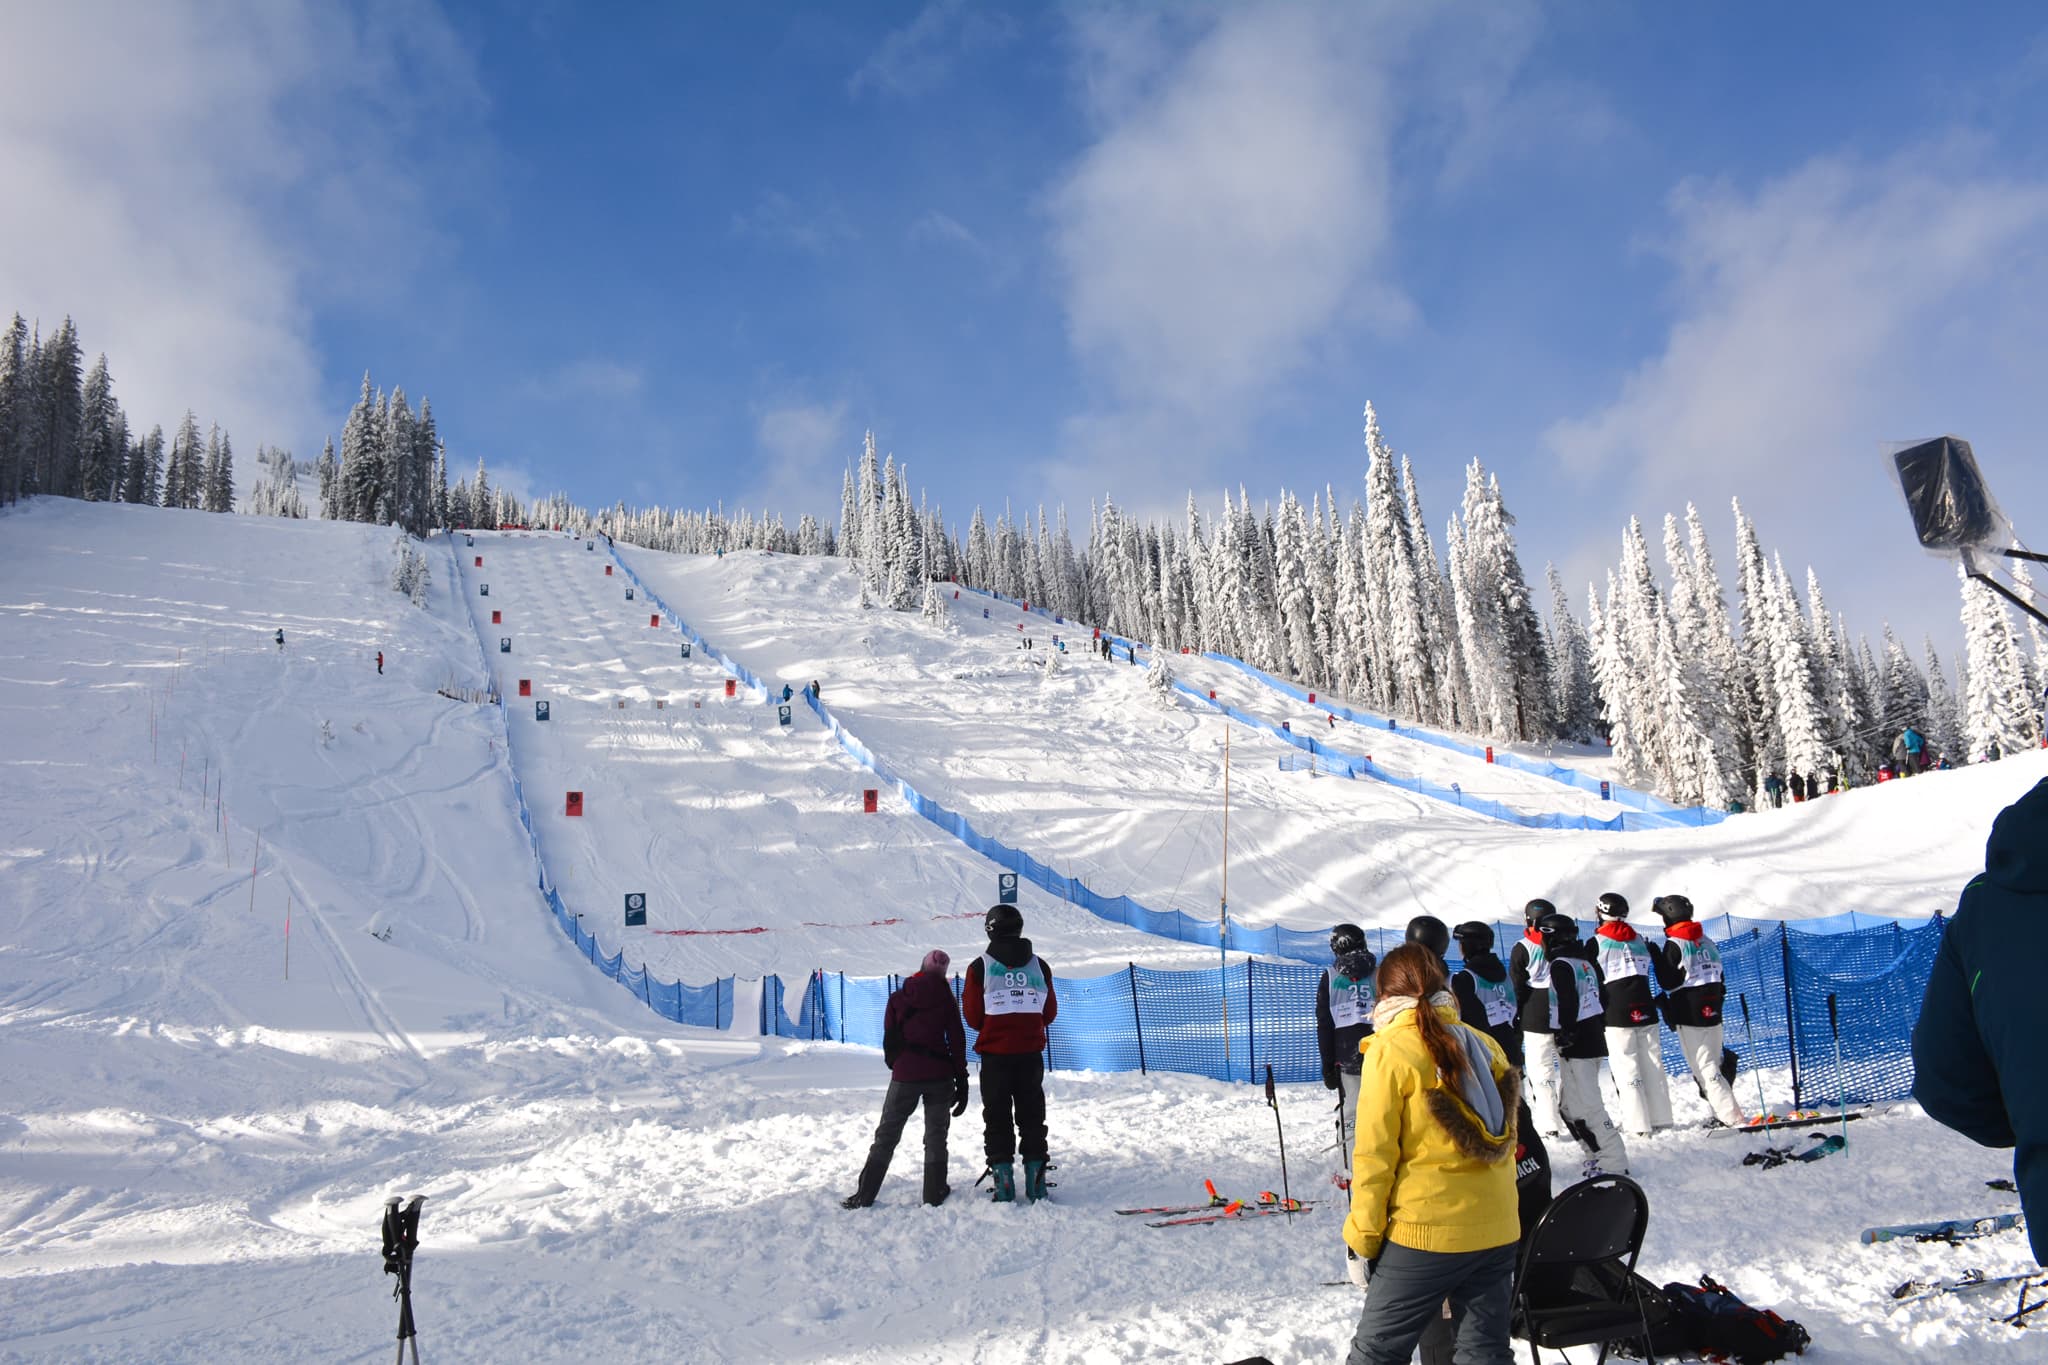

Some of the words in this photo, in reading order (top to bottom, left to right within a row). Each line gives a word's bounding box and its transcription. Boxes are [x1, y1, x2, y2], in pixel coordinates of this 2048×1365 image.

[1004, 972, 1028, 988] 89
[1348, 984, 1370, 1000] 25
[1492, 984, 1506, 998] 19
[1516, 1157, 1540, 1179] ACH
